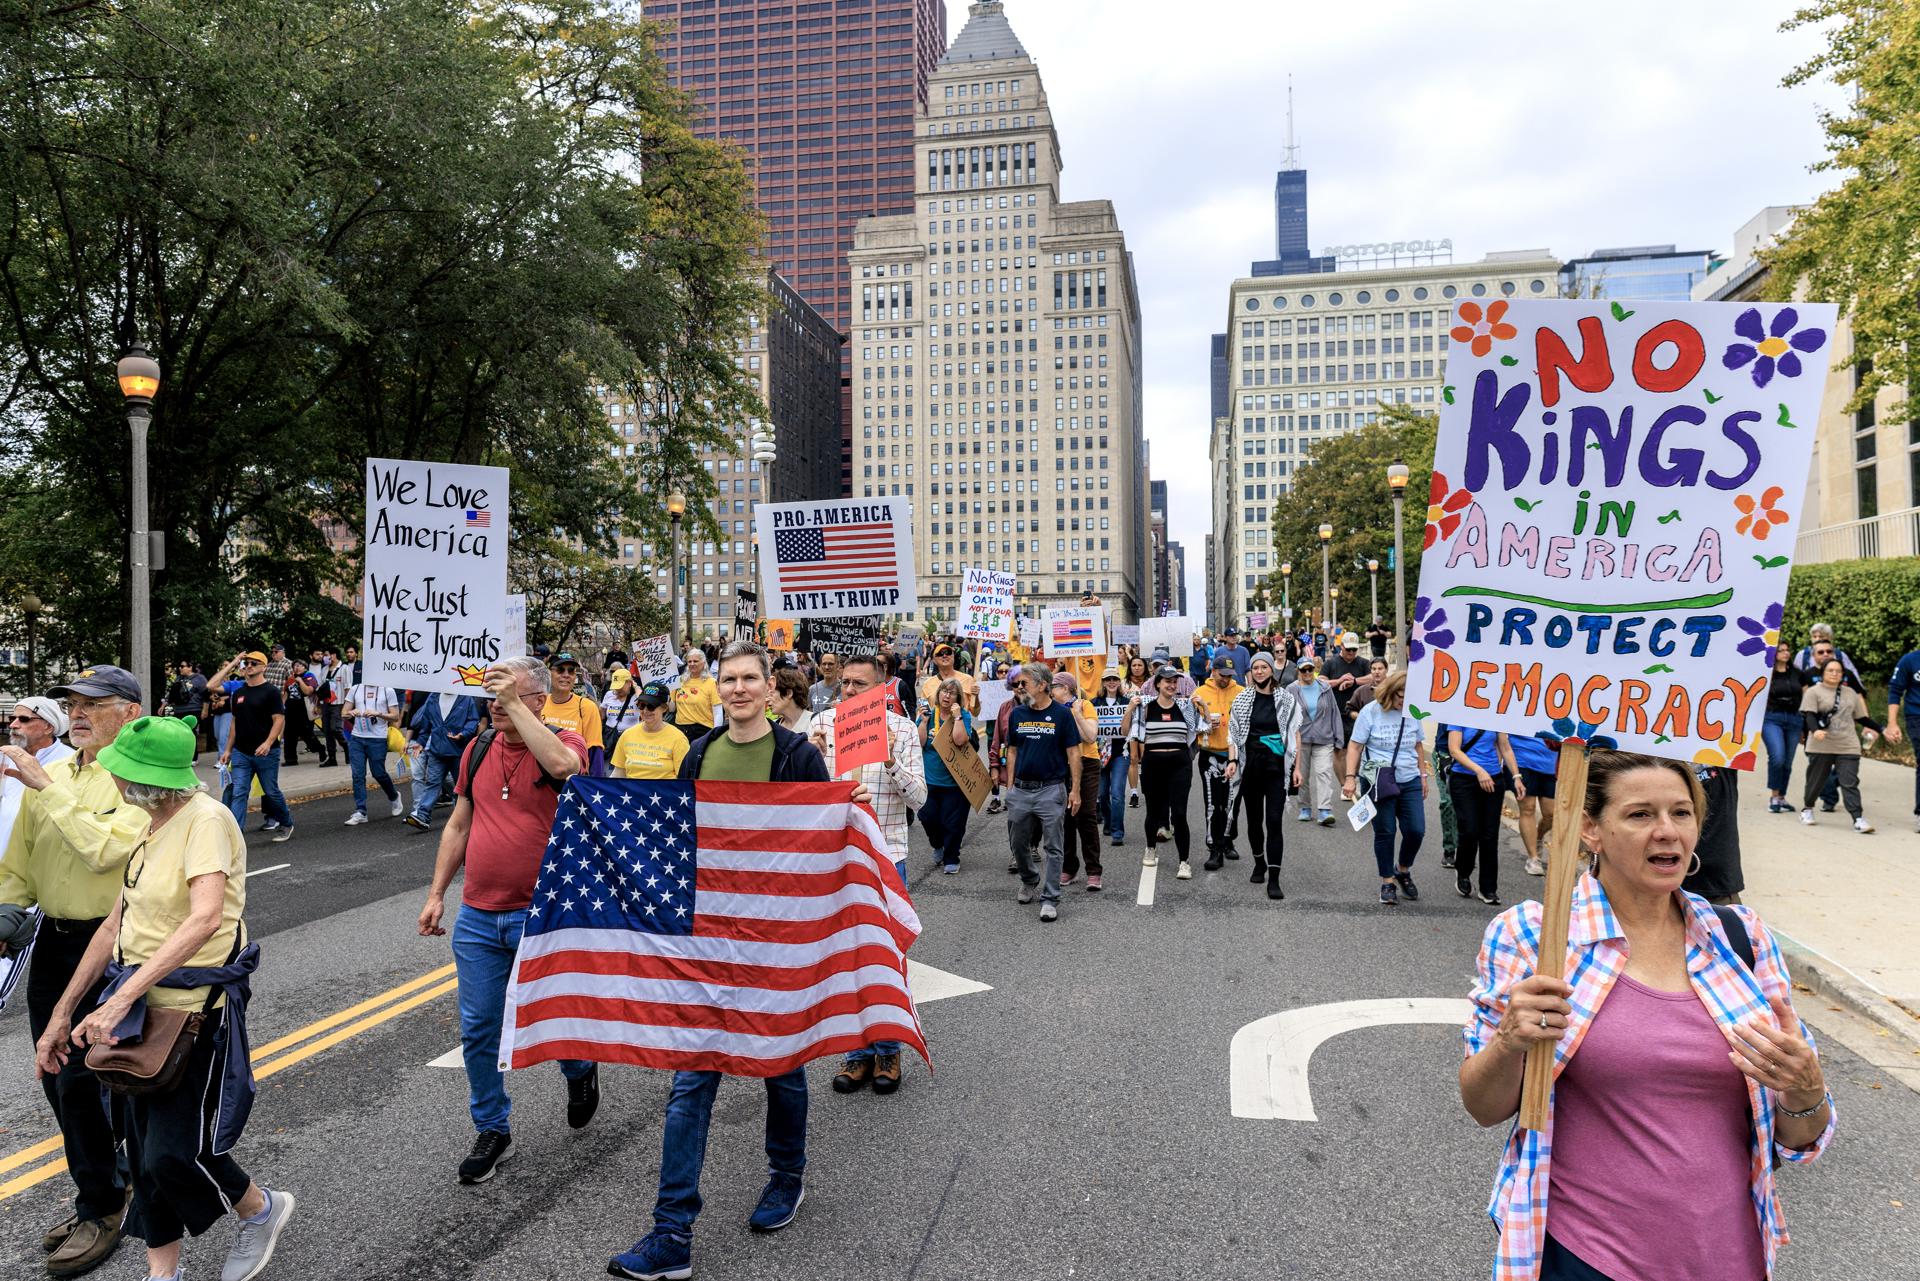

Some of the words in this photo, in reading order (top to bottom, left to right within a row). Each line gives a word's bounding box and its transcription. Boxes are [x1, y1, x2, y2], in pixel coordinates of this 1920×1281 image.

[1324, 238, 1452, 257] MOTOROLA
[1535, 316, 1706, 407] NO
[372, 464, 418, 505] We
[426, 468, 489, 510] Love
[773, 505, 893, 528] PRO-AMERICA
[369, 507, 489, 558] America
[1445, 501, 1724, 583] AMERICA
[370, 572, 412, 611] We
[414, 577, 470, 617] Just
[967, 585, 993, 594] HONOR
[995, 587, 1015, 597] YOUR
[783, 588, 900, 611] ANTI-TRUMP
[972, 595, 1003, 606] OATH
[968, 604, 988, 614] NOT
[989, 607, 1013, 617] YOUR
[821, 624, 834, 634] THE
[834, 626, 865, 638] ANSWER
[981, 631, 1006, 640] TROOPS
[1465, 603, 1727, 658] PROTECT
[370, 614, 424, 653] Hate
[426, 617, 501, 674] Tyrants
[637, 635, 668, 648] HATE
[641, 645, 666, 656] WILL
[645, 652, 667, 662] NOT
[383, 661, 397, 671] NO
[399, 662, 429, 674] KINGS
[638, 657, 672, 672] MAKE
[651, 666, 667, 677] US
[1429, 649, 1768, 745] DEMOCRACY
[1097, 707, 1115, 716] NDS
[845, 720, 862, 736] Donald
[863, 716, 882, 728] Trump
[1033, 727, 1056, 735] DONOR
